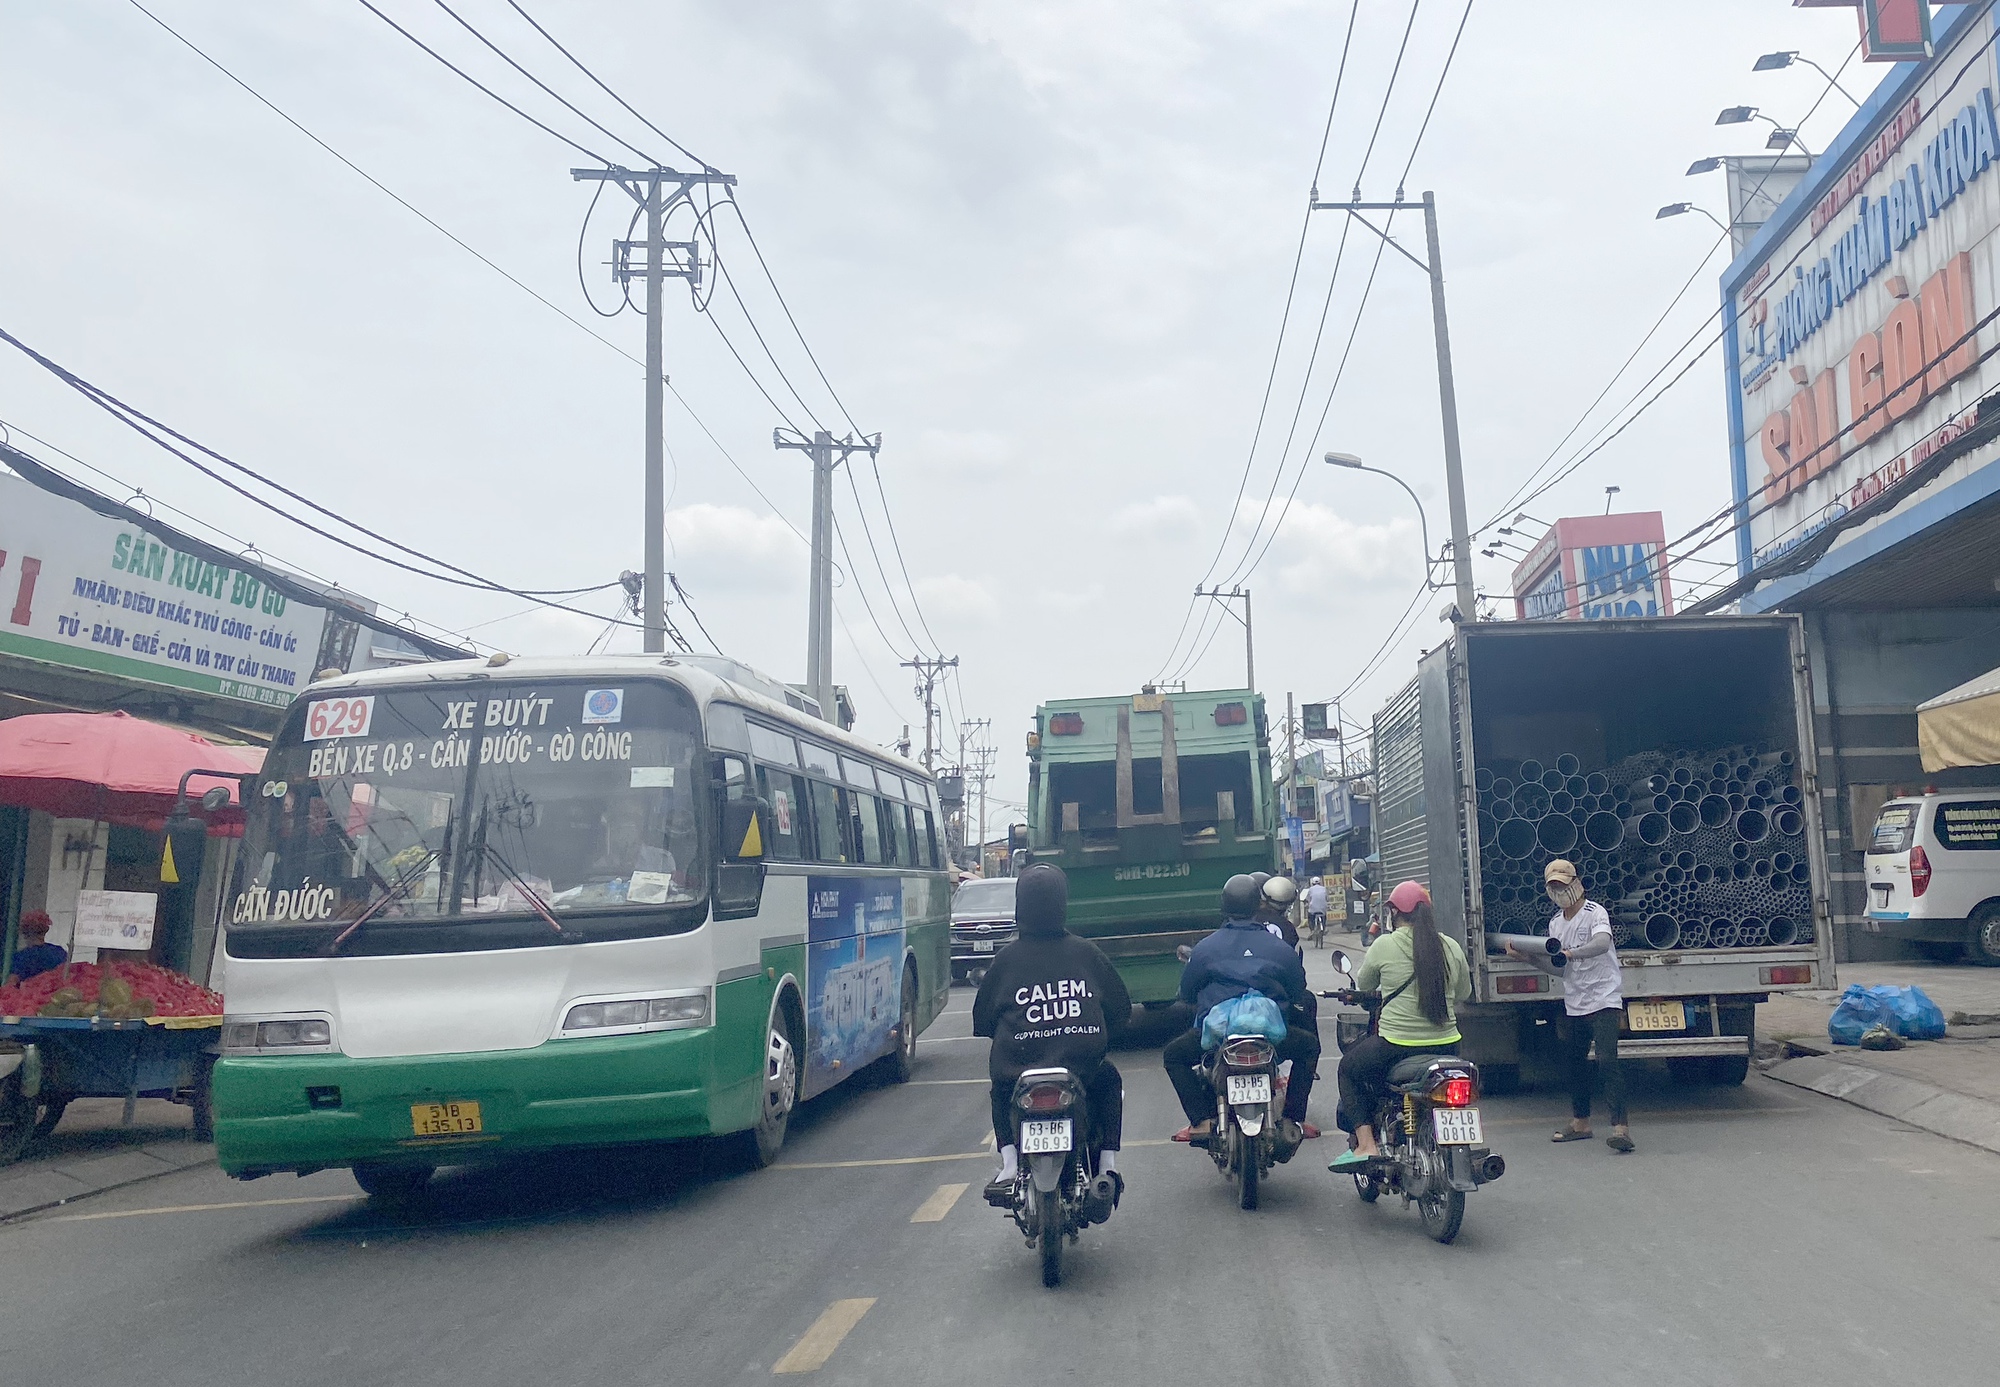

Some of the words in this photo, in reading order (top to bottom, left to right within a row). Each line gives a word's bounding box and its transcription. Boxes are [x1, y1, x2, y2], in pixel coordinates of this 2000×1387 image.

[1774, 258, 1833, 362] PHÒNG
[1830, 195, 1891, 307] KHÁM
[1923, 87, 2000, 218] KHOA
[1760, 365, 1841, 506] SÀI
[1848, 252, 1978, 445] GÒN
[1583, 543, 1652, 596] NHA
[221, 618, 252, 641] CÔNG
[91, 620, 124, 647] BÀN
[132, 630, 160, 655] GHẾ
[195, 644, 210, 667] VÀ
[214, 652, 235, 672] TAY
[261, 664, 296, 686] THANG
[310, 699, 366, 737] 629
[442, 701, 477, 730] XE
[484, 692, 553, 726] BUÝT
[309, 737, 348, 778] BẾN
[351, 743, 376, 773] XE
[383, 744, 413, 777] Q.8
[430, 728, 470, 768] CẦN
[480, 726, 530, 764] ĐƯỚC
[550, 726, 576, 762] GÒ
[581, 726, 632, 760] CÔNG
[233, 878, 271, 924] CẦN
[273, 876, 334, 921] ĐƯỚC
[1015, 980, 1093, 1005] CALEM.
[1026, 1000, 1081, 1023] CLUB
[1643, 1003, 1668, 1015] 51C
[1014, 1027, 1062, 1040] COPYRIGHT
[1635, 1015, 1679, 1029] 819.99
[1231, 1089, 1268, 1103] 234.33
[421, 1119, 475, 1133] 135.13
[1443, 1126, 1476, 1141] 0816
[1024, 1136, 1069, 1151] 496.93
